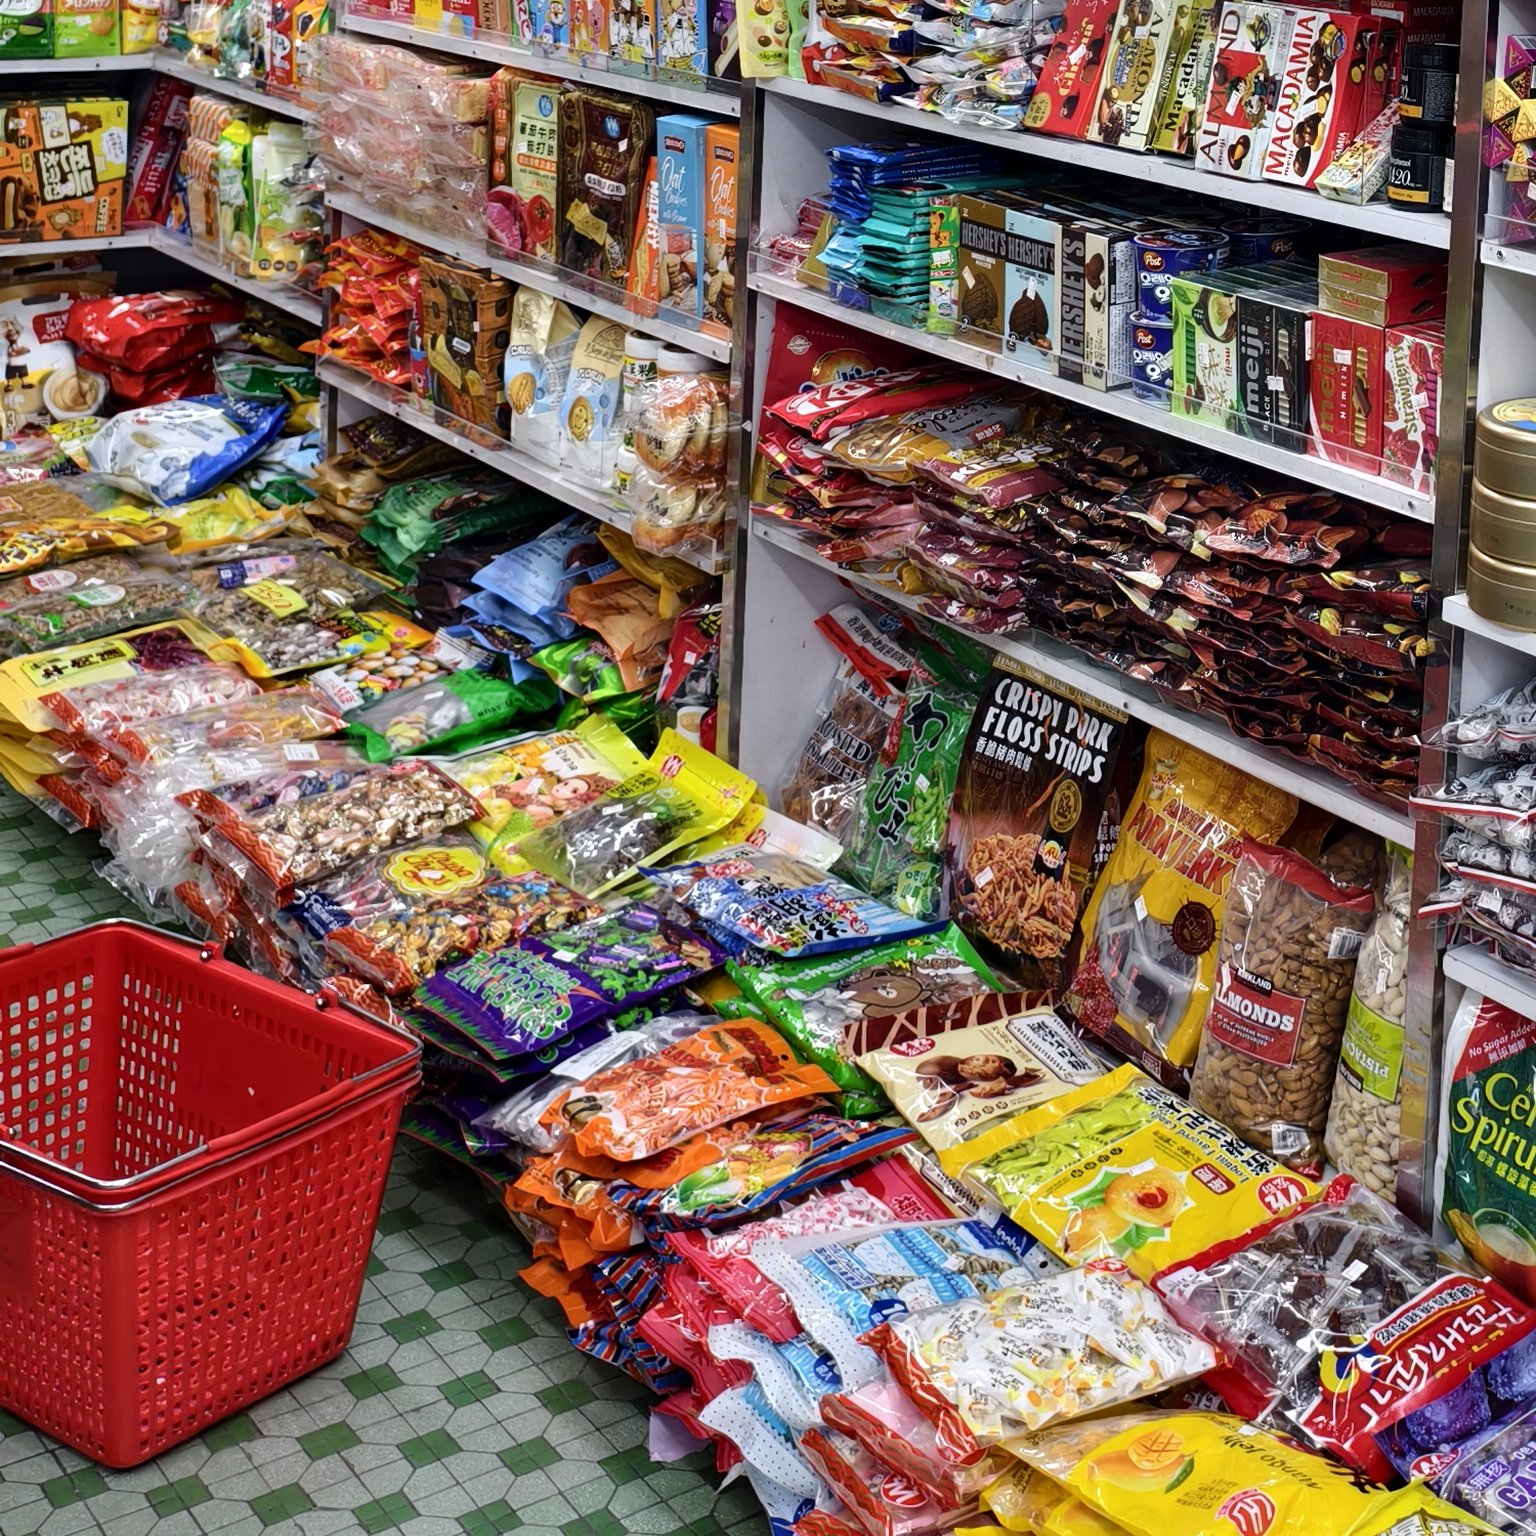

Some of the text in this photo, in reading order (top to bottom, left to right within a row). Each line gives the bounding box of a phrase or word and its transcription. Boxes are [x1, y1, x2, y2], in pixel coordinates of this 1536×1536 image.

[1200, 8, 1241, 166] ALMOND
[1265, 14, 1317, 176] MACADAMIA
[660, 155, 687, 191] Oat
[961, 221, 1008, 256] HERSHEY'S
[1142, 253, 1166, 269] Post
[1058, 237, 1085, 375] HERSHEY'S
[1243, 323, 1261, 415] meiji
[982, 706, 1107, 784] FLOSS STRIPS
[995, 678, 1115, 753] CRISPY PORK
[1236, 968, 1273, 991] KIRKLAND
[1468, 1022, 1536, 1059] No Sugar Added
